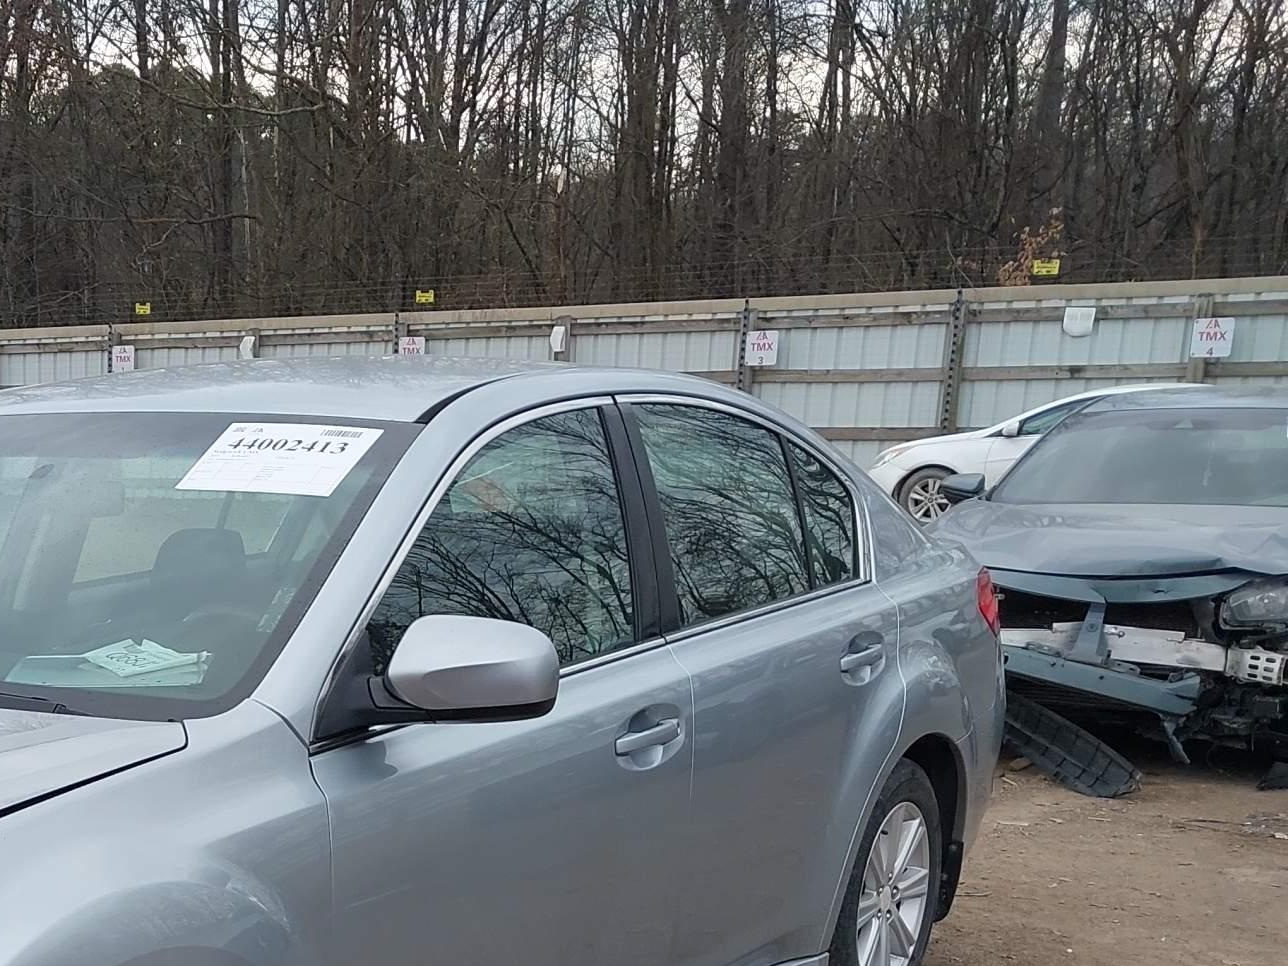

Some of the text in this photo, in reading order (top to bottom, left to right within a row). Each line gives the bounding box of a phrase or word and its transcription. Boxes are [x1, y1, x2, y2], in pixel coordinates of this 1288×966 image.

[1198, 331, 1227, 341] TMX
[751, 342, 774, 351] TMX
[1206, 347, 1214, 356] 4
[758, 356, 764, 365] 3
[228, 437, 349, 455] 44002413
